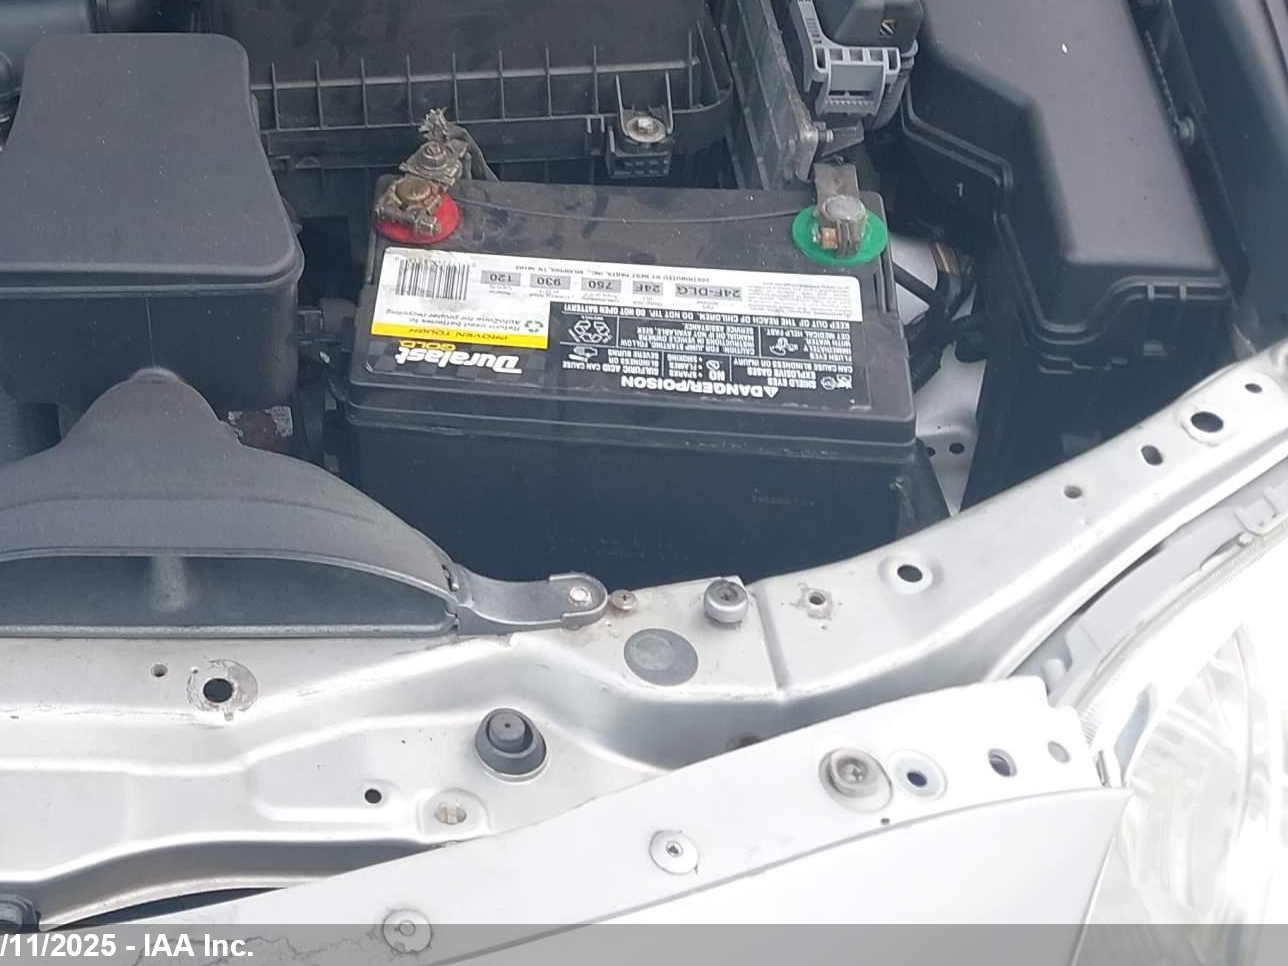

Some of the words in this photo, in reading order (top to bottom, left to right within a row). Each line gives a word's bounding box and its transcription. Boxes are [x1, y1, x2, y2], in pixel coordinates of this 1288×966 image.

[489, 274, 512, 282] 120
[537, 276, 561, 286] 930
[589, 280, 612, 289] 750
[635, 284, 660, 293] 24F
[677, 286, 740, 297] 24F-DLG
[599, 306, 618, 314] OPEN
[620, 308, 634, 316] NOT
[664, 311, 680, 319] NOT
[682, 312, 693, 320] DO
[752, 317, 779, 325] REACH
[781, 318, 796, 326] THE
[812, 320, 827, 328] OUT
[830, 321, 850, 329] KEEP
[726, 325, 753, 334] SERVICE
[693, 330, 708, 338] NOT
[727, 332, 753, 341] MANUAL
[805, 331, 835, 339] MEDICAL
[621, 340, 648, 348] FOLLOW
[668, 336, 695, 344] VEHICLE
[705, 337, 754, 348] INSTRUCTIONS
[832, 339, 851, 347] WITH
[399, 339, 456, 351] GOLD
[685, 344, 704, 352] JUMP
[608, 349, 631, 357] BURNS
[803, 345, 851, 354] IMMEDIATELY
[633, 351, 659, 359] SEVERE
[667, 354, 698, 362] SMOKING
[395, 346, 522, 374] Duralast
[620, 358, 659, 366] BLINDNESS
[734, 358, 759, 366] INJURY
[563, 361, 585, 369] CAUSE
[603, 364, 620, 372] ACID
[669, 362, 697, 370] FLAMES
[772, 361, 812, 370] BLINDNESS
[814, 364, 836, 372] CAUSE
[838, 365, 853, 373] CAN
[623, 365, 659, 375] SULFURIC
[669, 370, 697, 378] SPARKS
[747, 367, 771, 376] GASES
[773, 368, 816, 379] EXPLOSIVE
[709, 371, 725, 380] NO
[767, 377, 787, 387] EYES
[789, 379, 816, 389] SHIELD
[621, 376, 763, 397] DANGER/POISON
